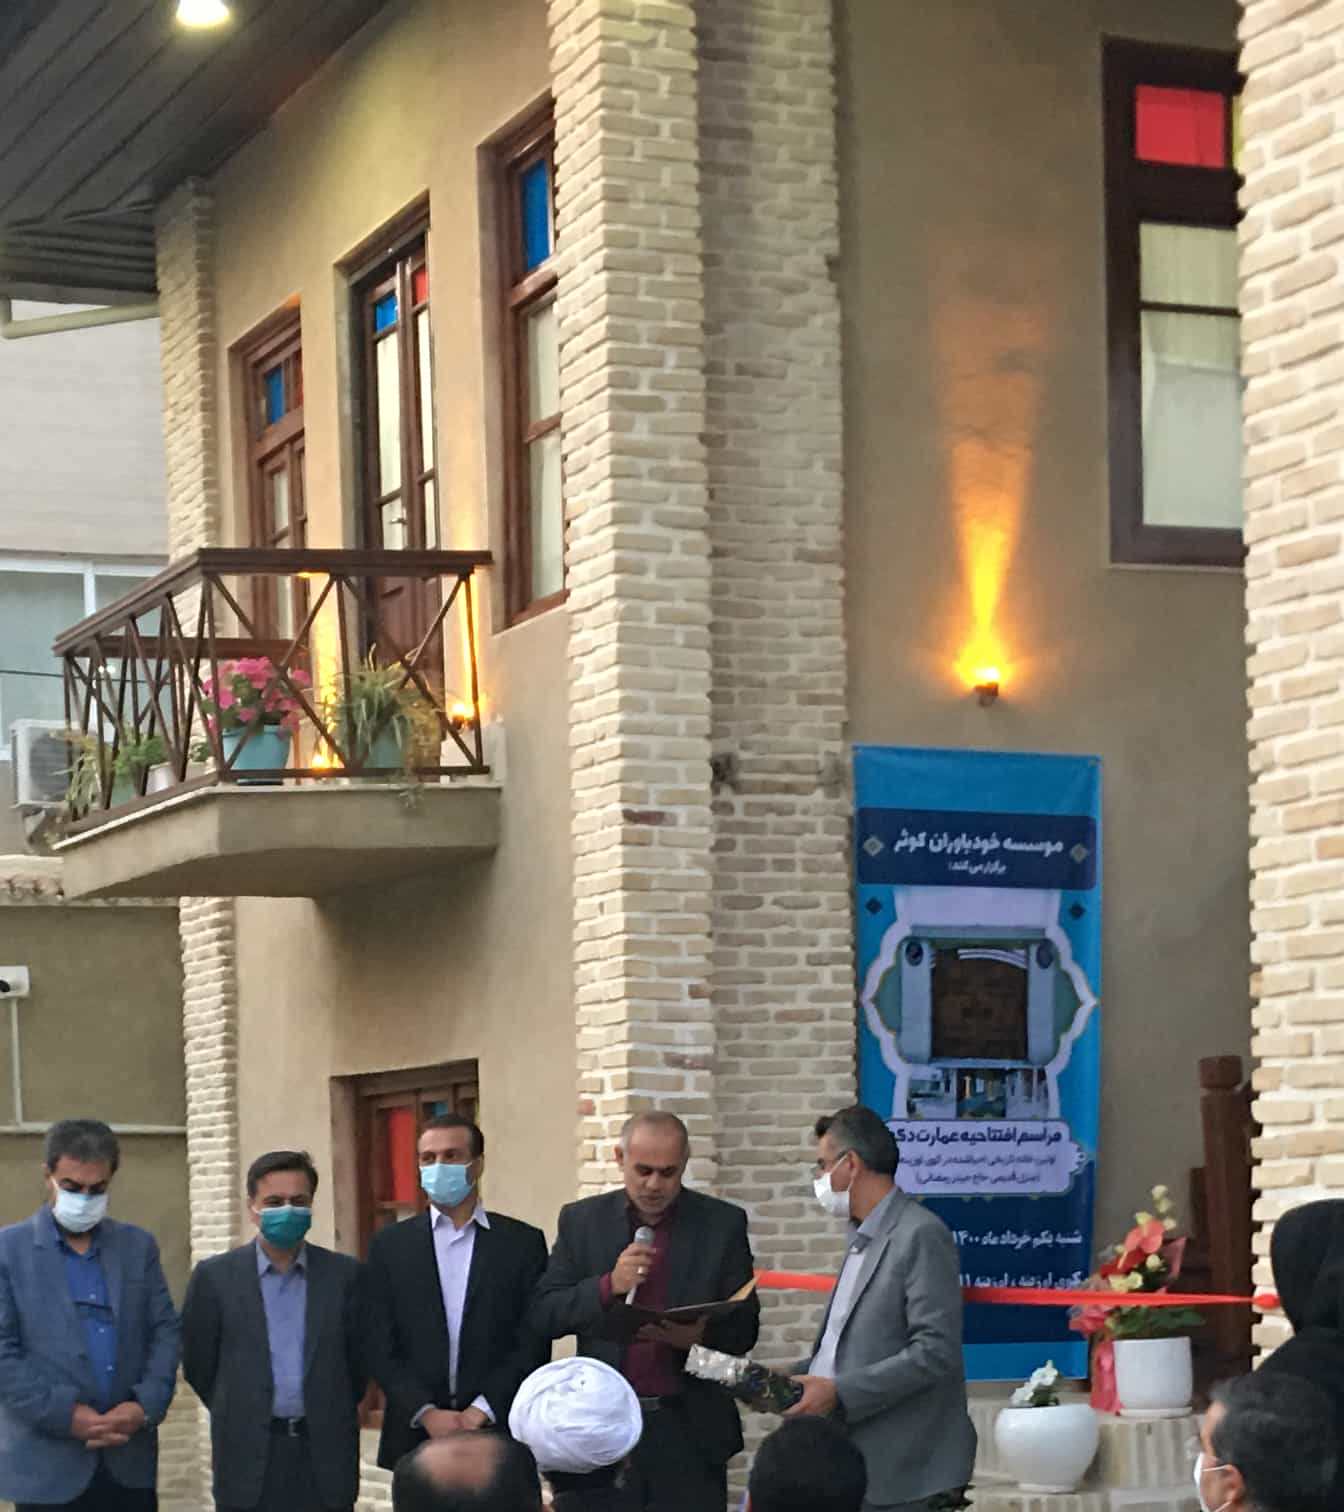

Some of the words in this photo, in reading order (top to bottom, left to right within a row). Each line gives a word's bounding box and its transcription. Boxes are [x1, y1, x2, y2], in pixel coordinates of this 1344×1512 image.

[893, 827, 927, 853] کوثر
[929, 831, 1001, 855] خودباوران
[1002, 837, 1065, 858] موسسه
[916, 1125, 959, 1147] عمارت
[960, 1125, 1017, 1146] افتتاحیه
[1017, 1127, 1063, 1147] مراسم
[952, 1230, 980, 1246] ۱۴۰۰
[981, 1230, 1000, 1246] ماه
[1000, 1229, 1032, 1250] خرداد
[1032, 1230, 1054, 1249] یکم
[1055, 1229, 1083, 1247] شنبه
